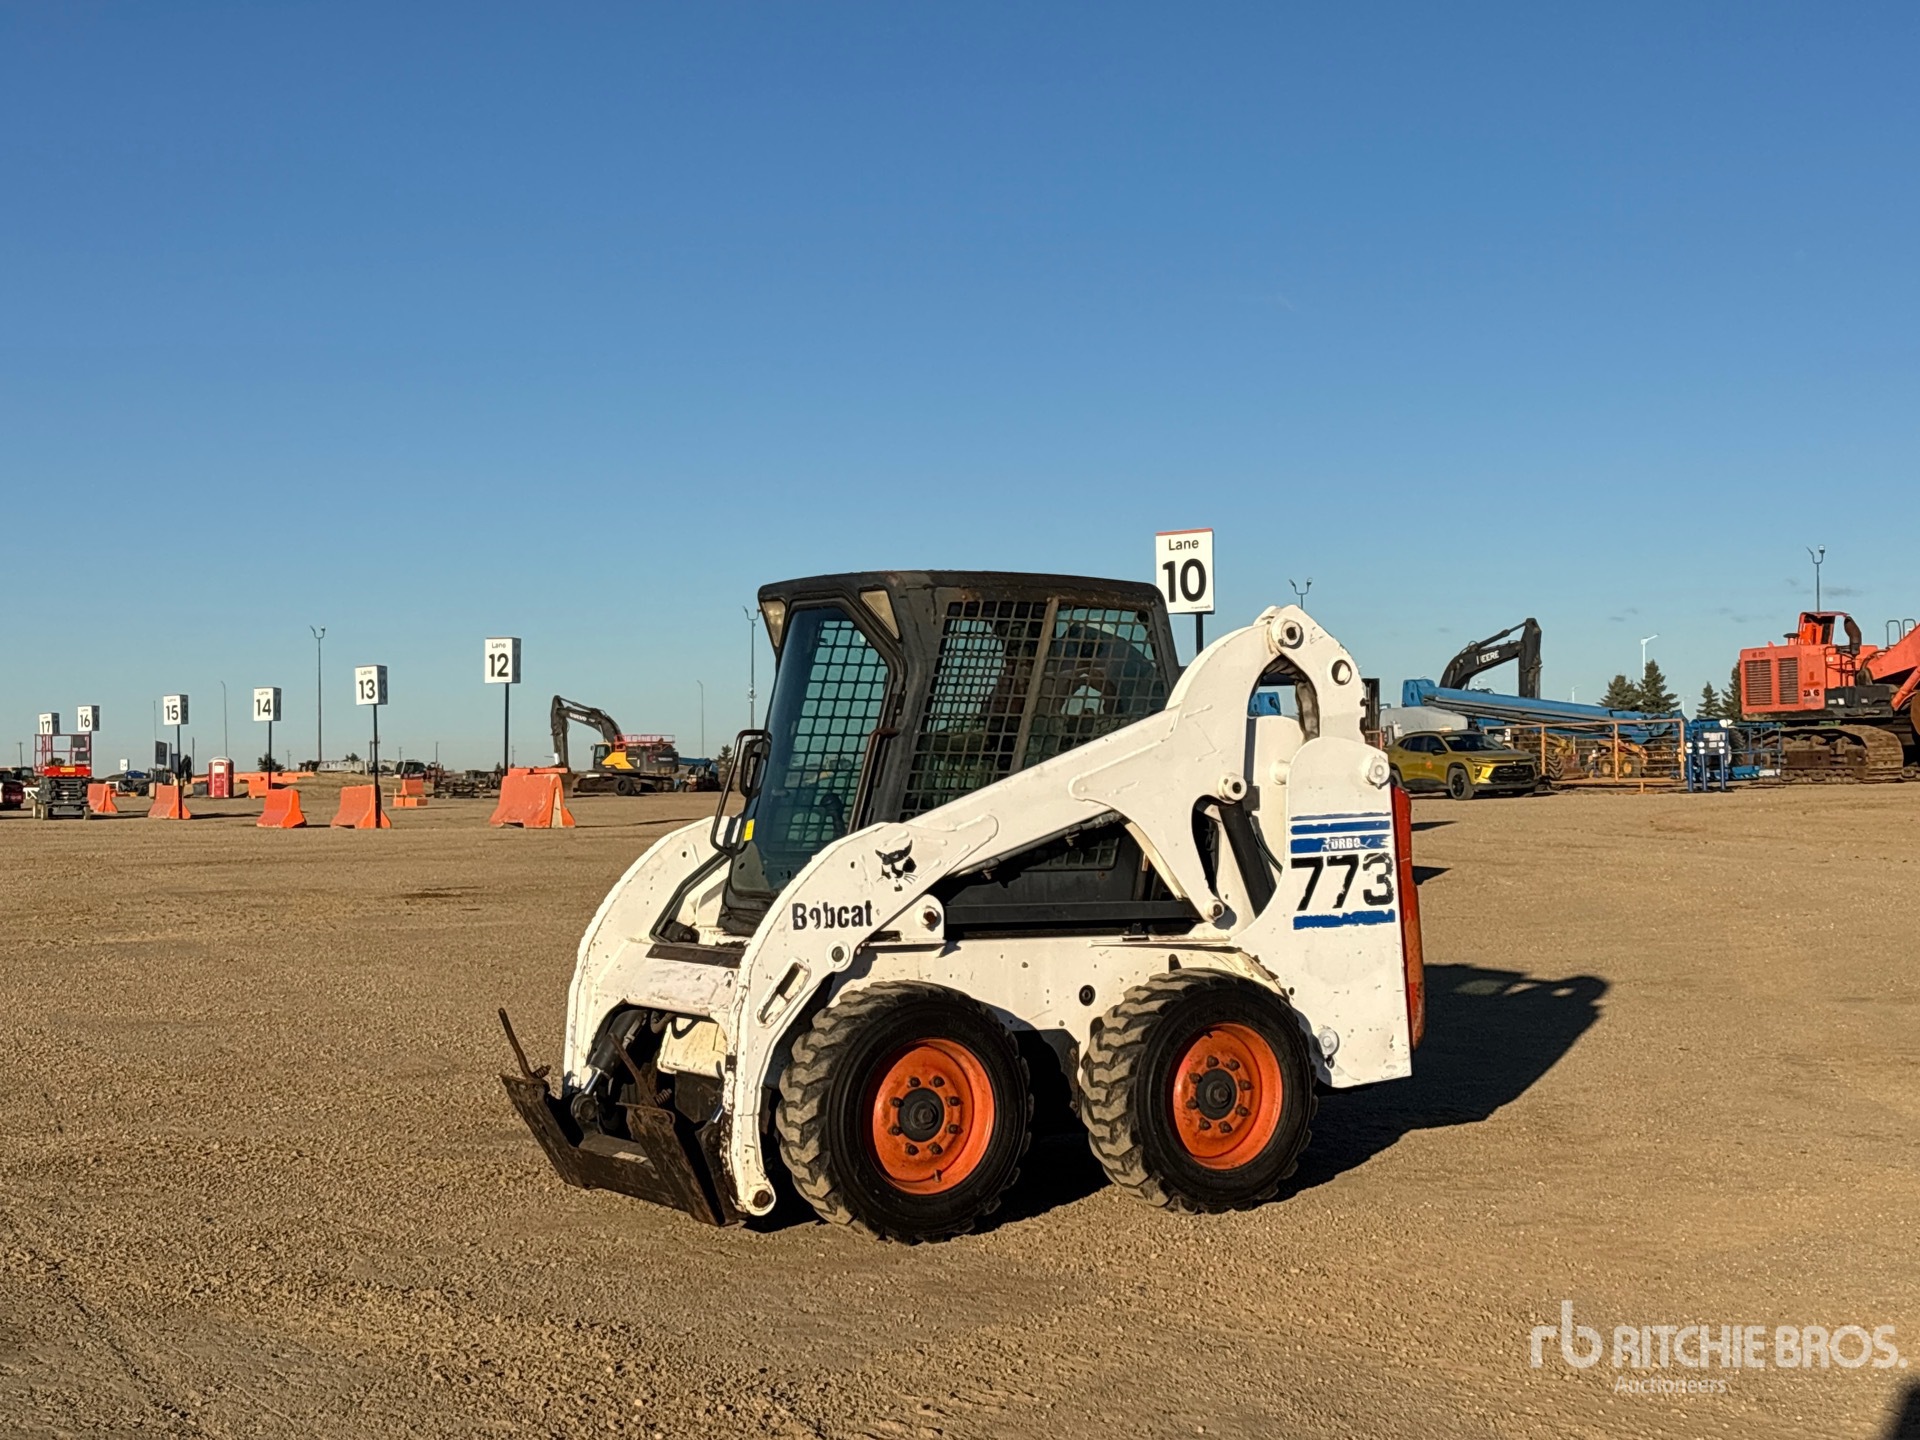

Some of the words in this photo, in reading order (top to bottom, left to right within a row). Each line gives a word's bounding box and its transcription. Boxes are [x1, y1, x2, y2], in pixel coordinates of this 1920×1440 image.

[1168, 538, 1199, 551] Lane
[1162, 558, 1207, 603] 10
[488, 652, 509, 677] 12
[358, 679, 376, 700] 13
[165, 704, 179, 721] 15
[256, 698, 272, 716] 14
[41, 720, 51, 734] 17
[80, 714, 91, 728] 16
[1323, 837, 1361, 850] TURBO
[1290, 852, 1394, 911] 773
[791, 900, 873, 931] Bobcat
